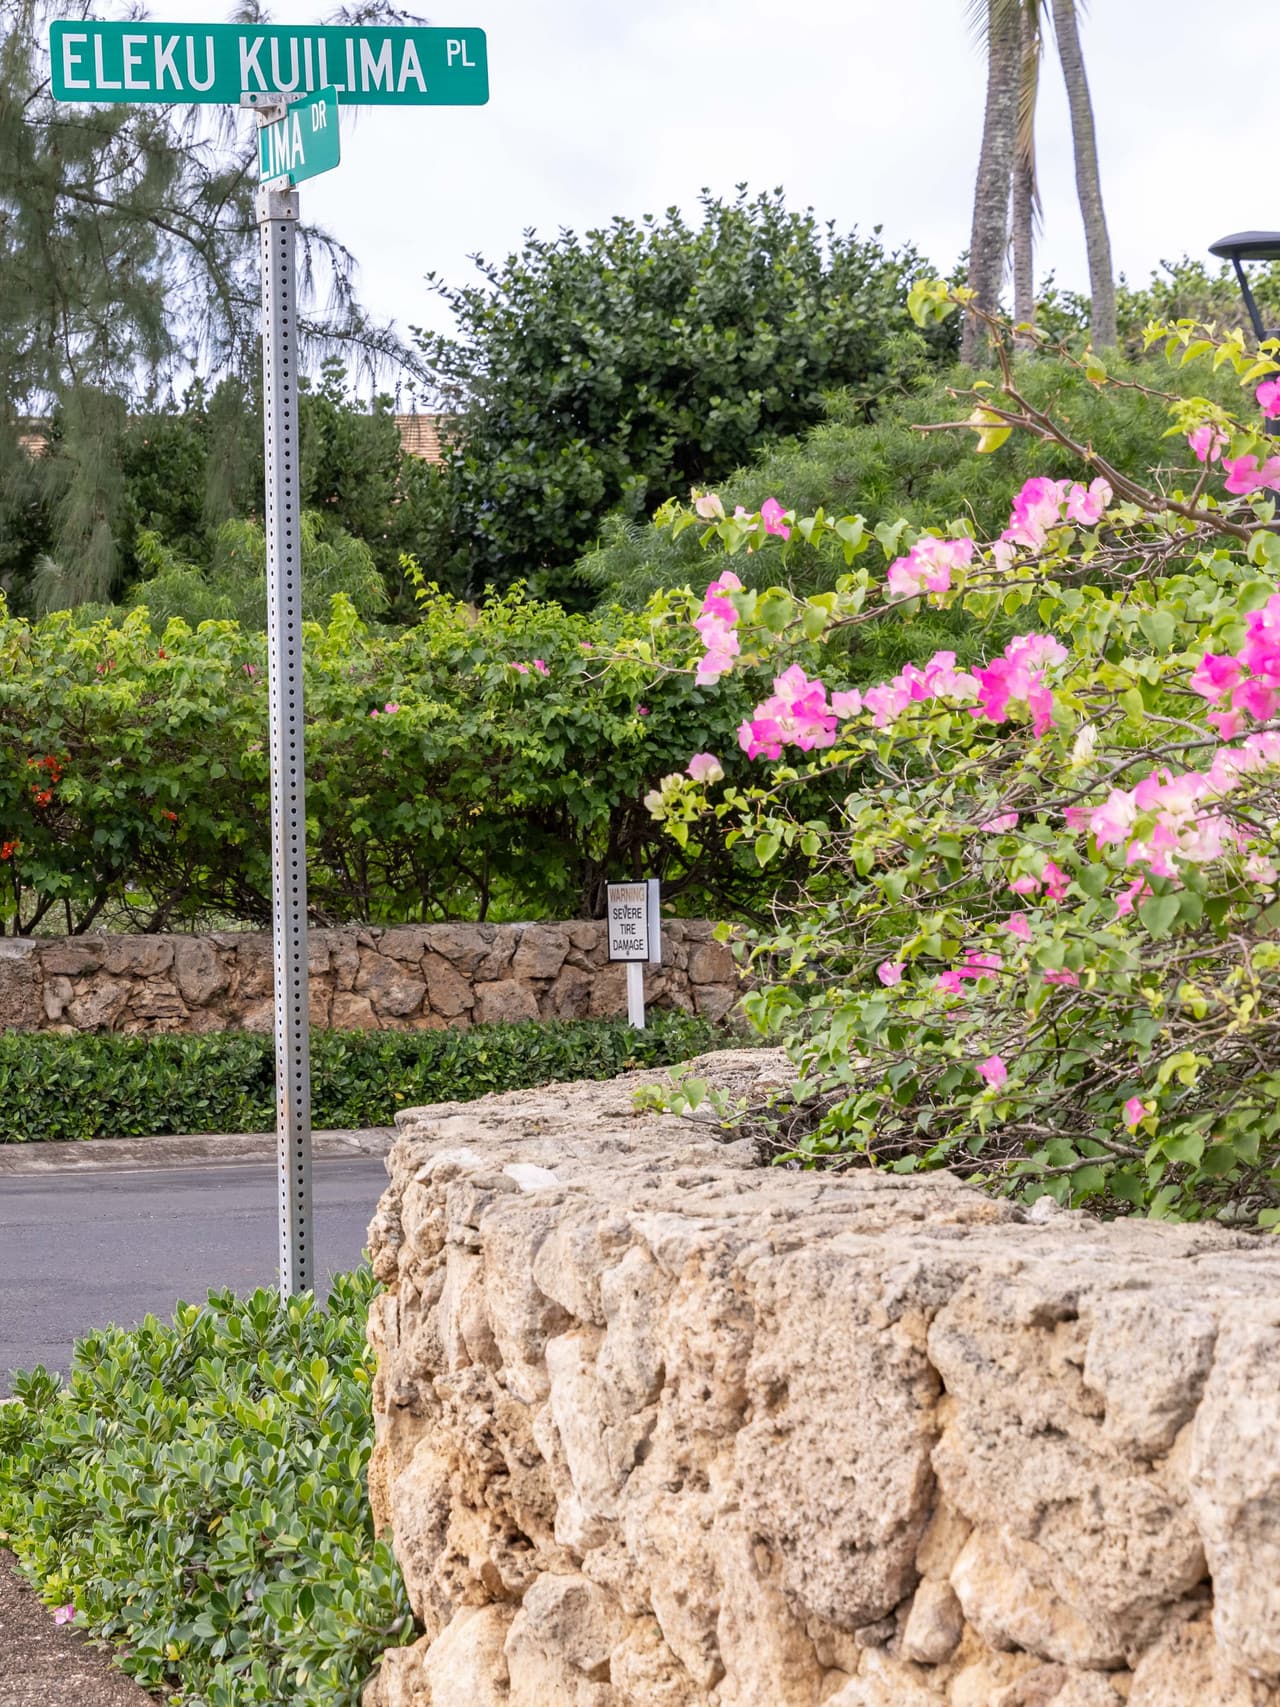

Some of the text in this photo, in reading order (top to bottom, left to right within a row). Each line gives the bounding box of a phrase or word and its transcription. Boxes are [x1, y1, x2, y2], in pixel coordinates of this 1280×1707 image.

[61, 33, 476, 93] ELEKU KUILIMA PL
[311, 99, 327, 132] DR
[609, 886, 645, 903] WARNING
[612, 907, 643, 920] SEVERE
[619, 923, 637, 935] TIRE
[612, 938, 645, 952] DAMAGE
